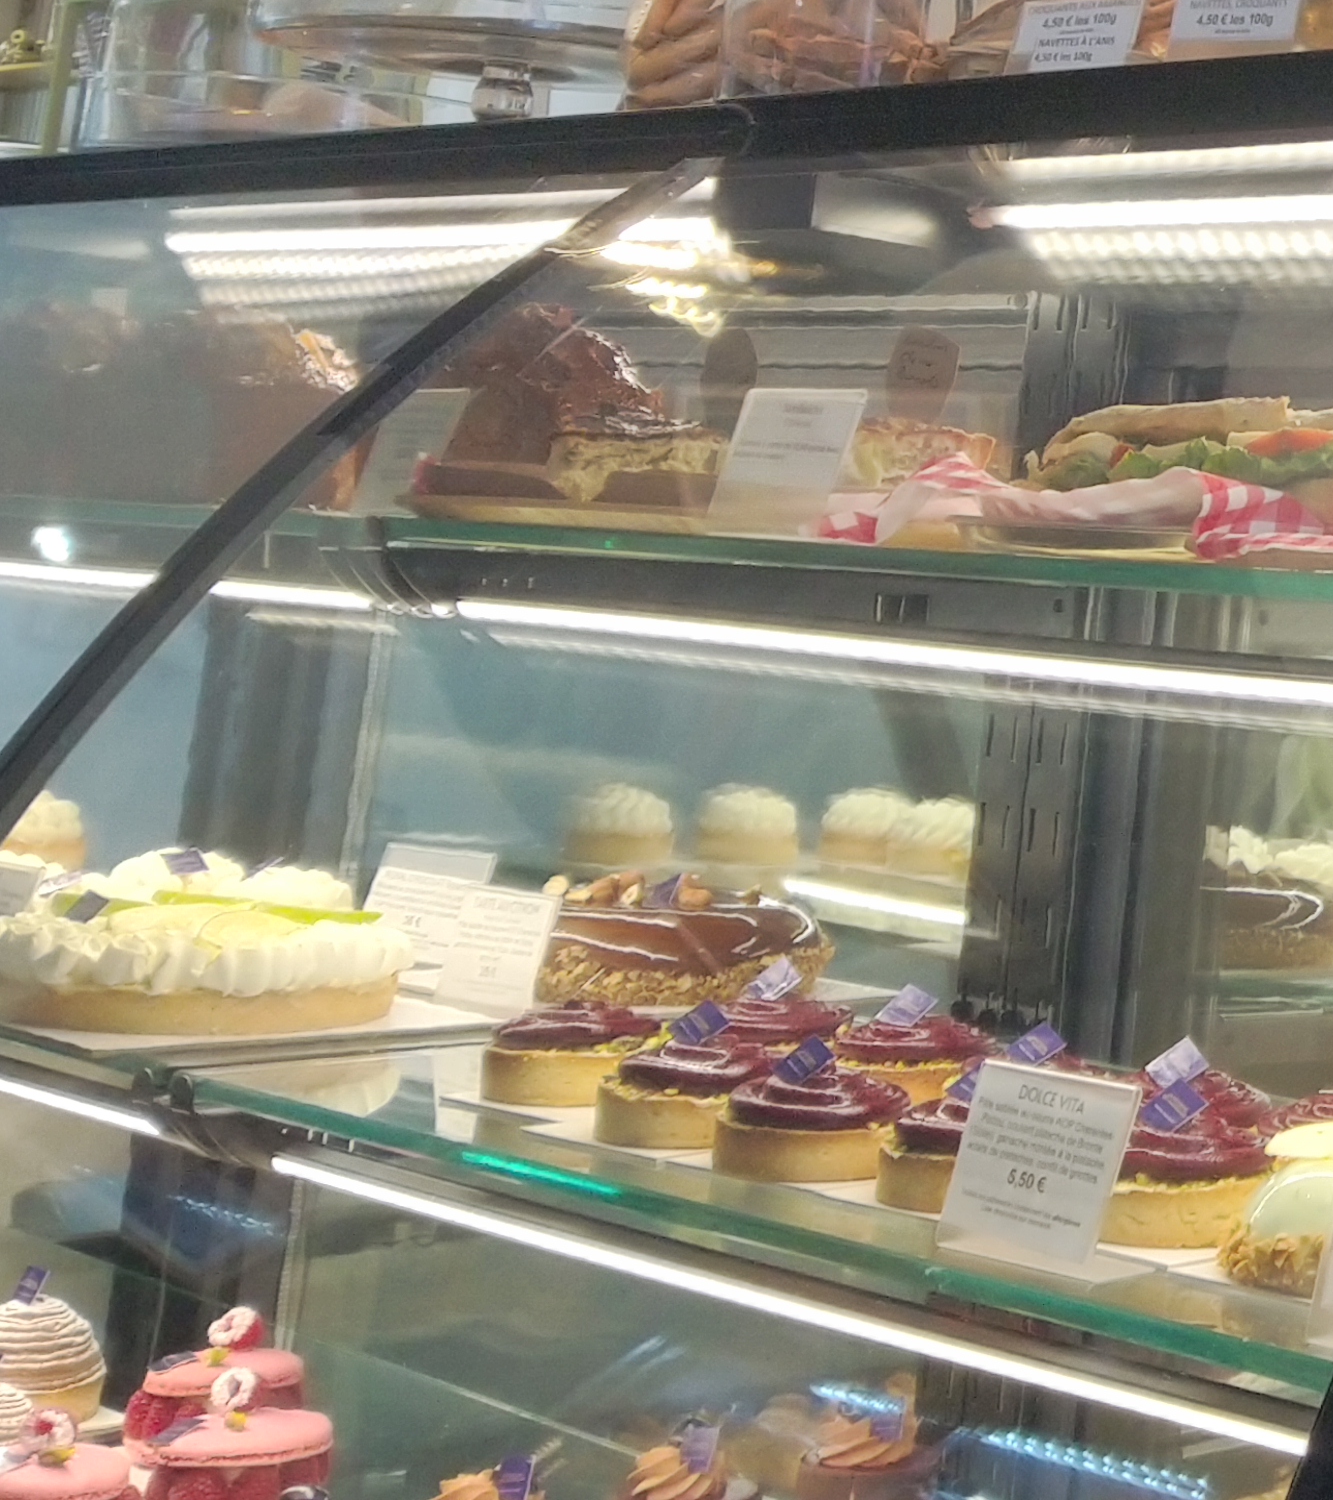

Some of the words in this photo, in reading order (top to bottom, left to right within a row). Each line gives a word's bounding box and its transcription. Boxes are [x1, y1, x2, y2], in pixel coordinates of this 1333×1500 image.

[1219, 12, 1228, 25] €
[1228, 13, 1245, 25] les
[1249, 12, 1273, 26] 100g
[1017, 1083, 1058, 1108] DOLCE
[1059, 1094, 1084, 1114] VITA
[1036, 1175, 1047, 1193] €
